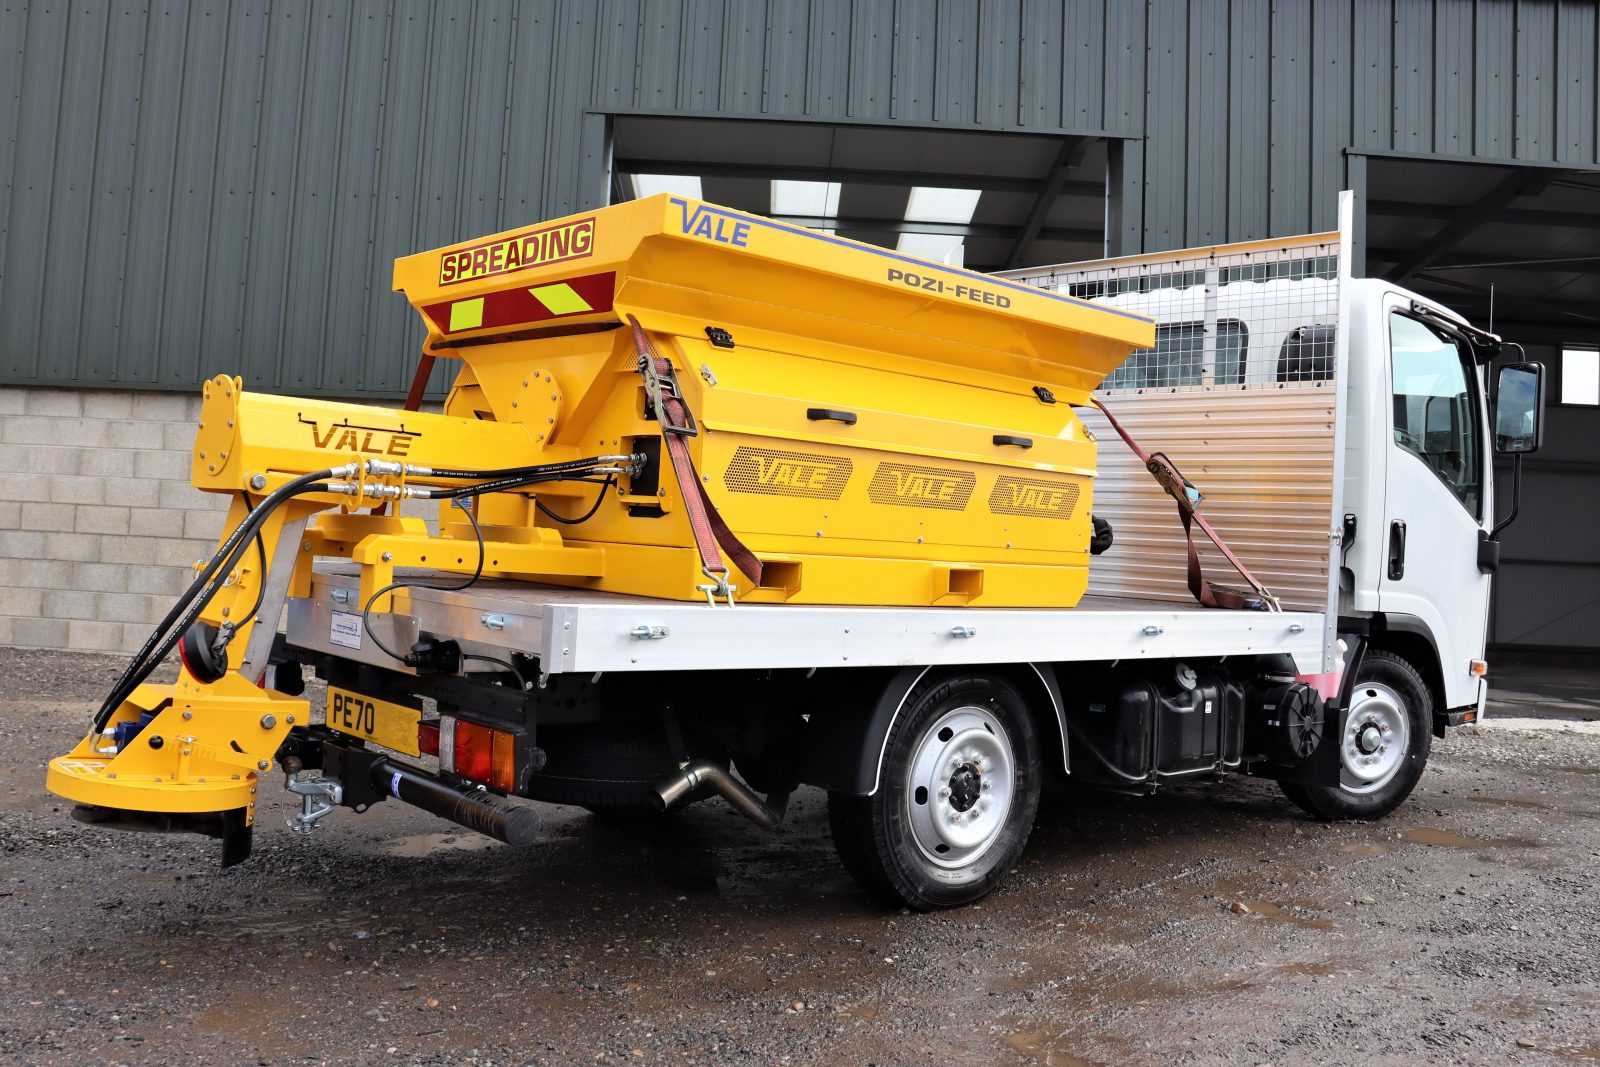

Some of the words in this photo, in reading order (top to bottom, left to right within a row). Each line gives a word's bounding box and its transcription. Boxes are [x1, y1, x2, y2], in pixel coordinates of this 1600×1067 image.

[669, 197, 751, 248] VALE
[442, 222, 592, 282] SPREADING
[887, 268, 1011, 309] POZI-FEED
[299, 418, 421, 457] VALE
[750, 456, 838, 489] VALE
[890, 470, 964, 501] VALE
[1007, 483, 1070, 511] VALE
[333, 692, 375, 735] PE70
